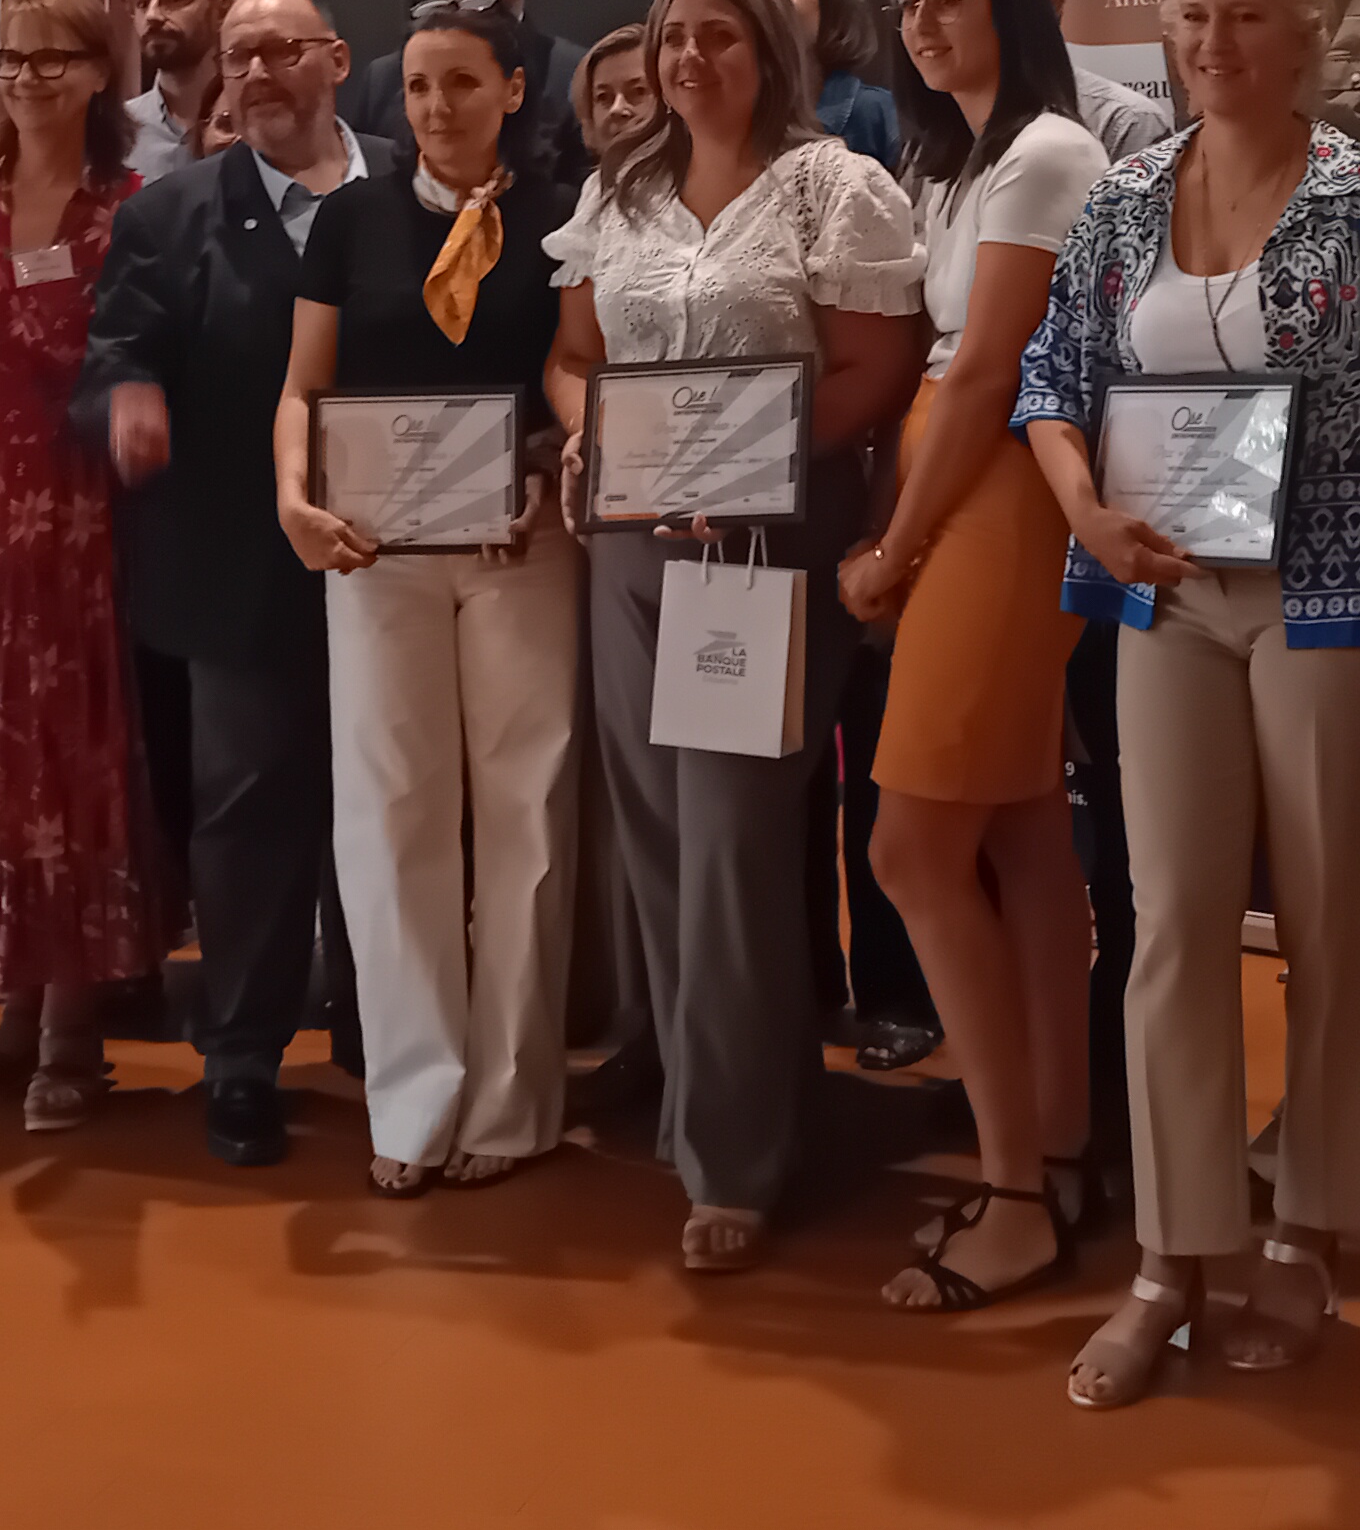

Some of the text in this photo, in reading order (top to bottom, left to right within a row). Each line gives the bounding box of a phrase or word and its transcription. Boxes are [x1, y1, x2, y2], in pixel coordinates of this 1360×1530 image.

[732, 647, 747, 657] LA
[697, 654, 747, 668] BANQUE
[696, 663, 747, 678] POSTALE
